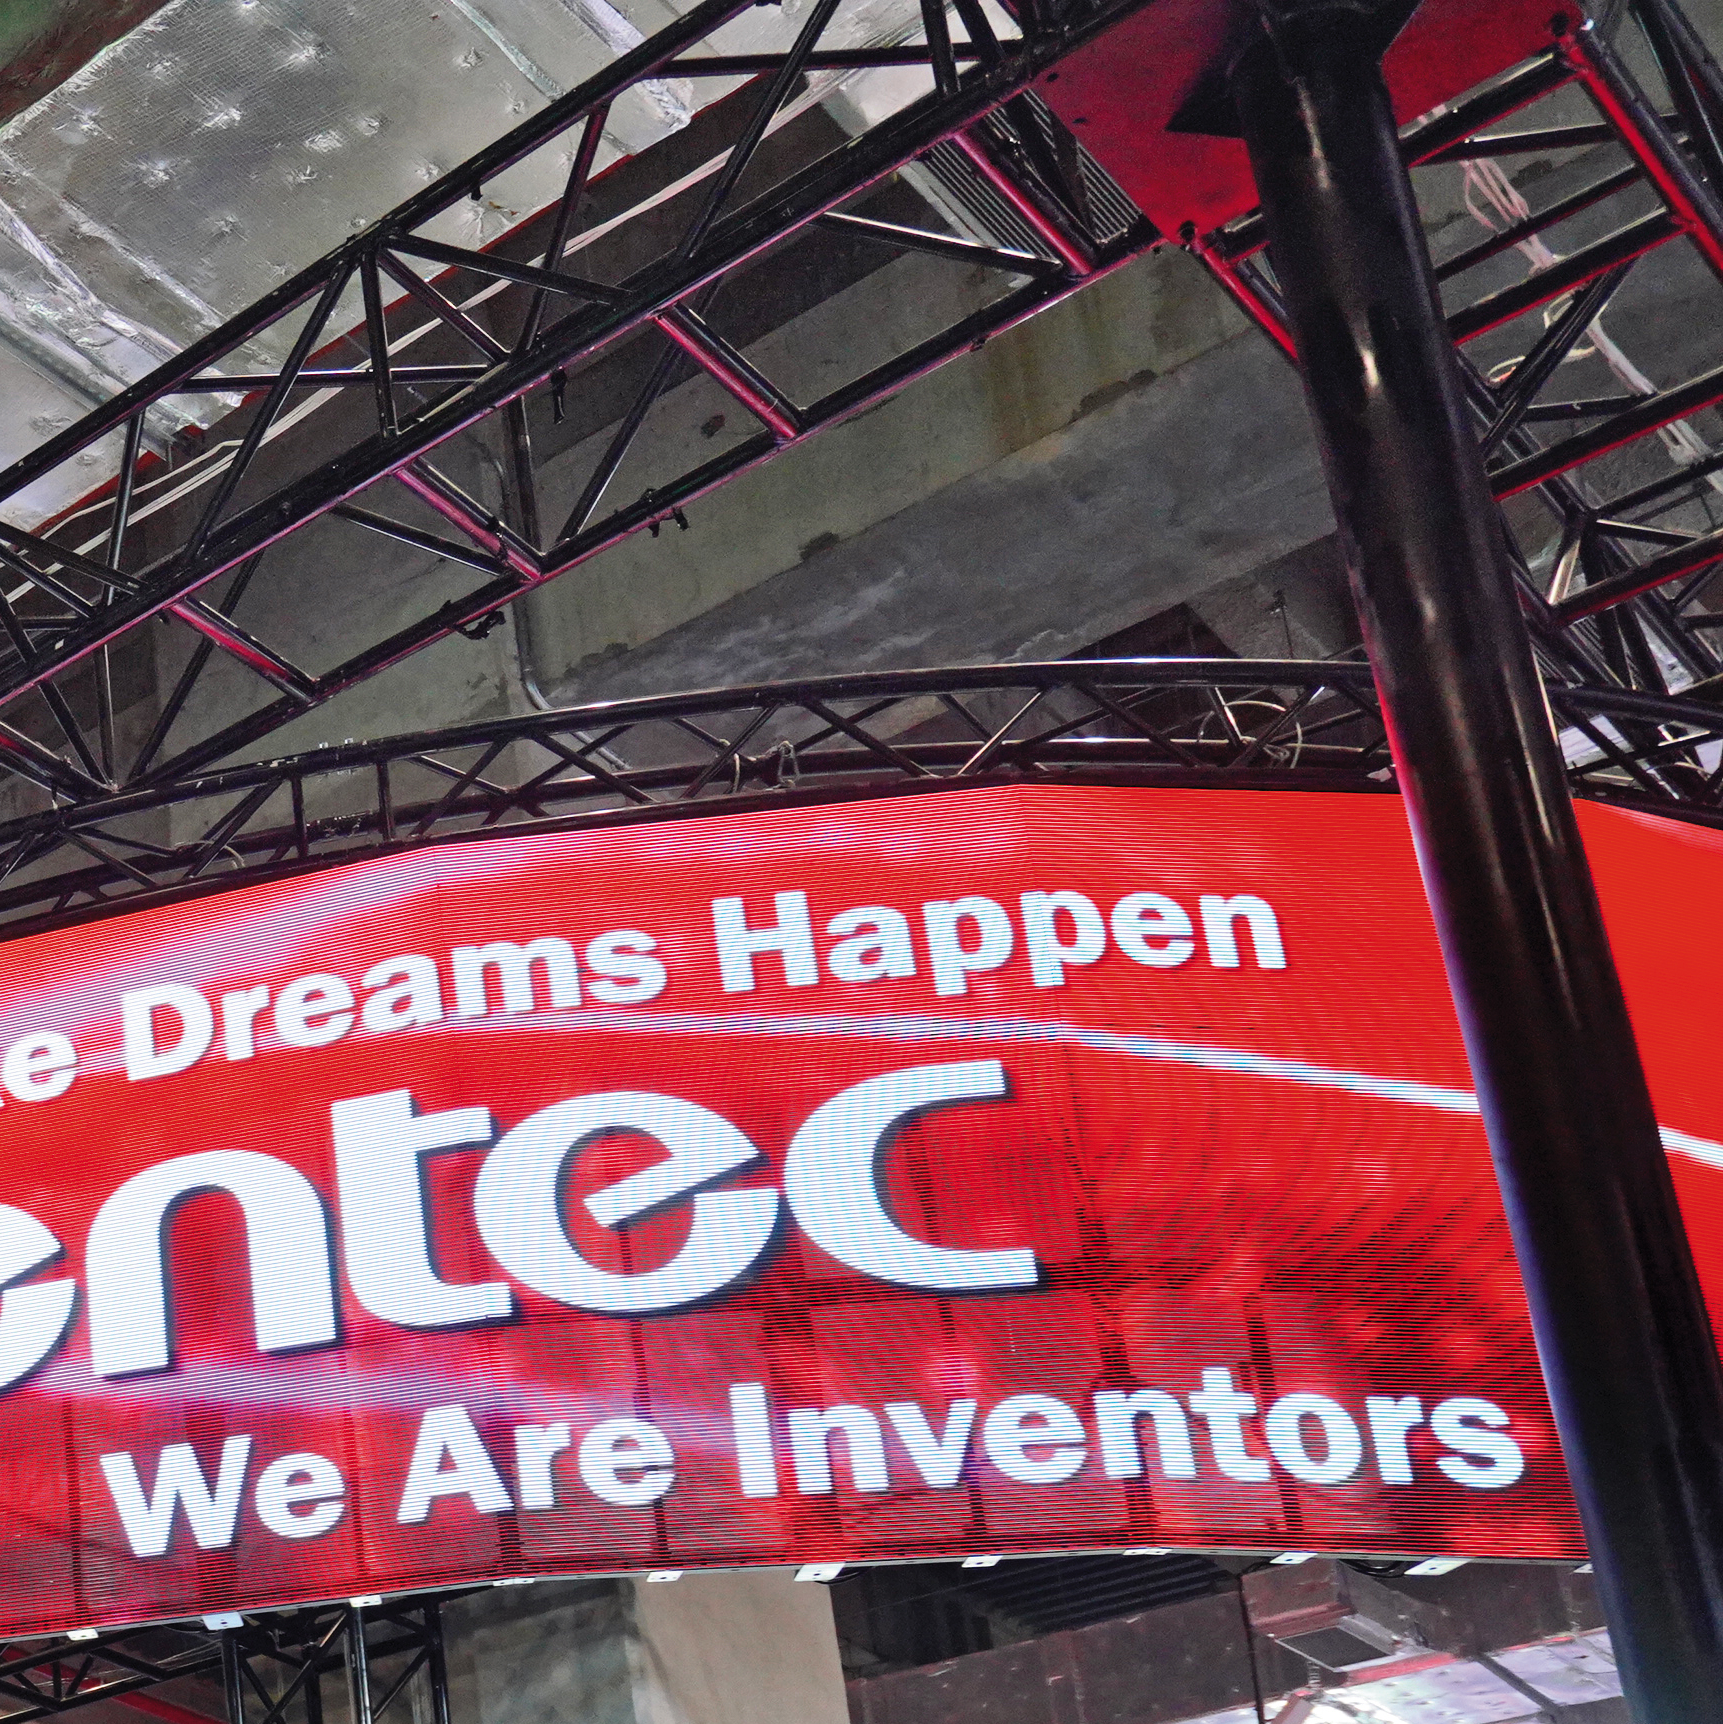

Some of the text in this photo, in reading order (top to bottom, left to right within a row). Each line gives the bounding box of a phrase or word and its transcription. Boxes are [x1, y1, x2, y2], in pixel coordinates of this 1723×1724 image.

[120, 920, 667, 1082] Dreams
[710, 888, 1287, 998] Happen
[100, 1366, 1525, 1558] We Are Inventors
